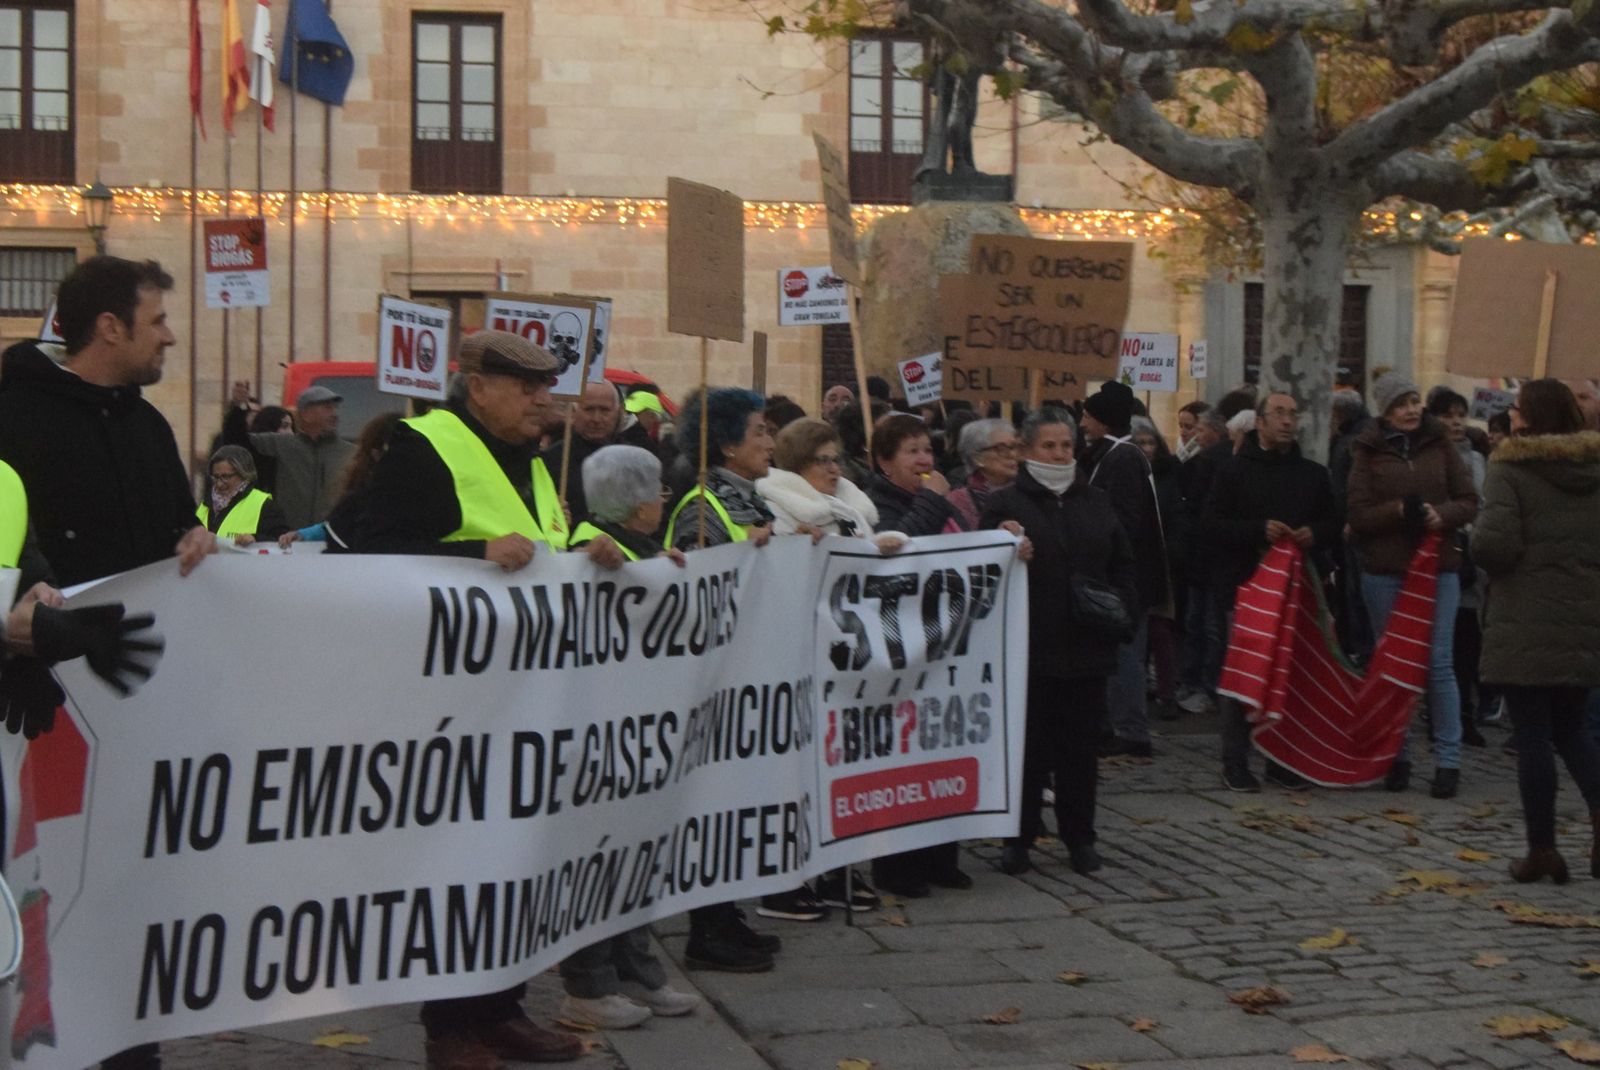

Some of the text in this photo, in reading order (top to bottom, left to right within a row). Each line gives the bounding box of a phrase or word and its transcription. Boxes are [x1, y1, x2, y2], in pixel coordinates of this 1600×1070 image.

[209, 234, 240, 251] STOP
[977, 247, 1015, 276] NO
[784, 279, 809, 292] STOP
[998, 282, 1034, 308] SER
[391, 324, 437, 373] NO
[1121, 338, 1141, 356] NO
[904, 366, 923, 379] STOP
[1140, 357, 1175, 367] PLANTA DE
[951, 366, 1003, 392] DEL
[423, 567, 740, 676] NO MALOS OLORES
[829, 563, 1002, 671] STOP
[144, 752, 232, 859] NO
[246, 716, 491, 844] EMISIÓN
[510, 728, 574, 820] DE
[572, 711, 678, 808] GASES
[835, 775, 966, 818] EL CUBO DEL VINO
[135, 913, 226, 1020] NO
[244, 835, 629, 1001] CONTAMINACIÓN
[620, 834, 669, 916] DE
